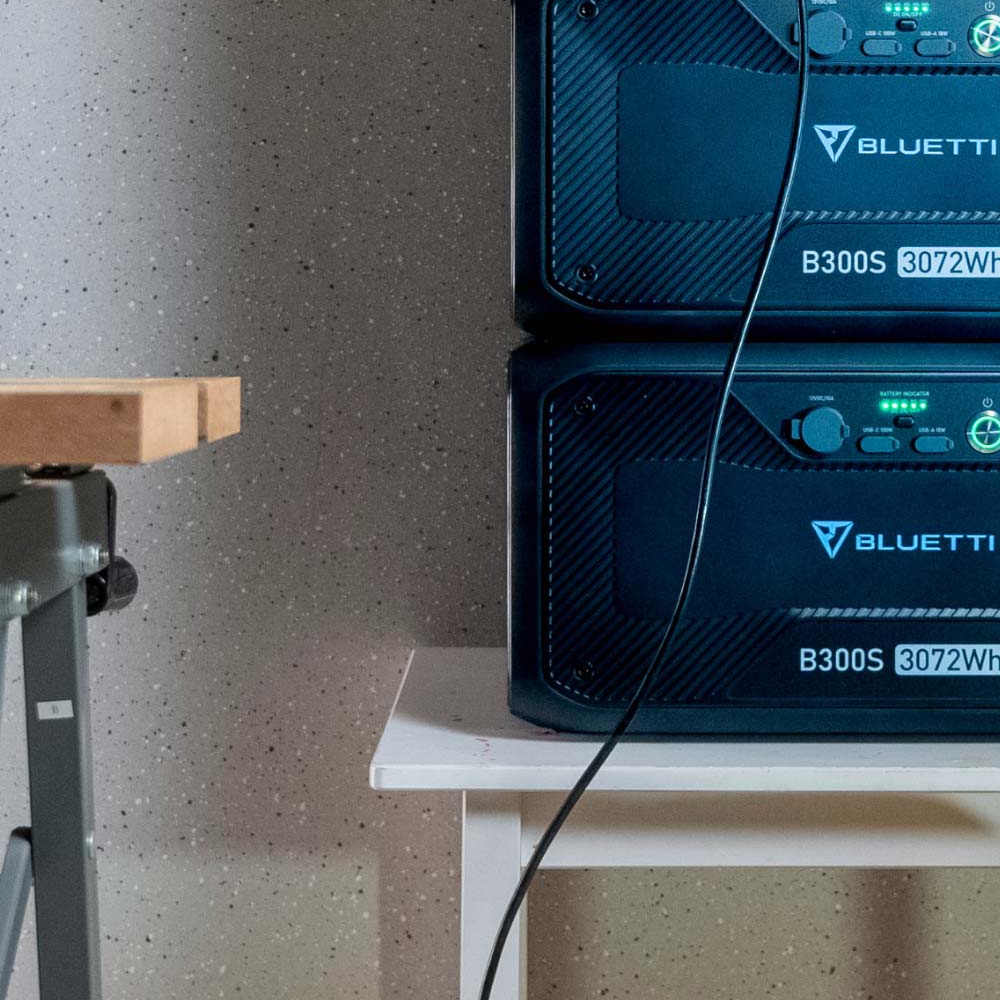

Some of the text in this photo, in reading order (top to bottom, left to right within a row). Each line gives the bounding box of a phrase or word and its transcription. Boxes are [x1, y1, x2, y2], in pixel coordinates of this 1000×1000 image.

[857, 137, 998, 156] BLUETTI
[802, 249, 888, 274] B300S
[855, 533, 995, 551] BLUETTI
[800, 647, 885, 672] B300S
